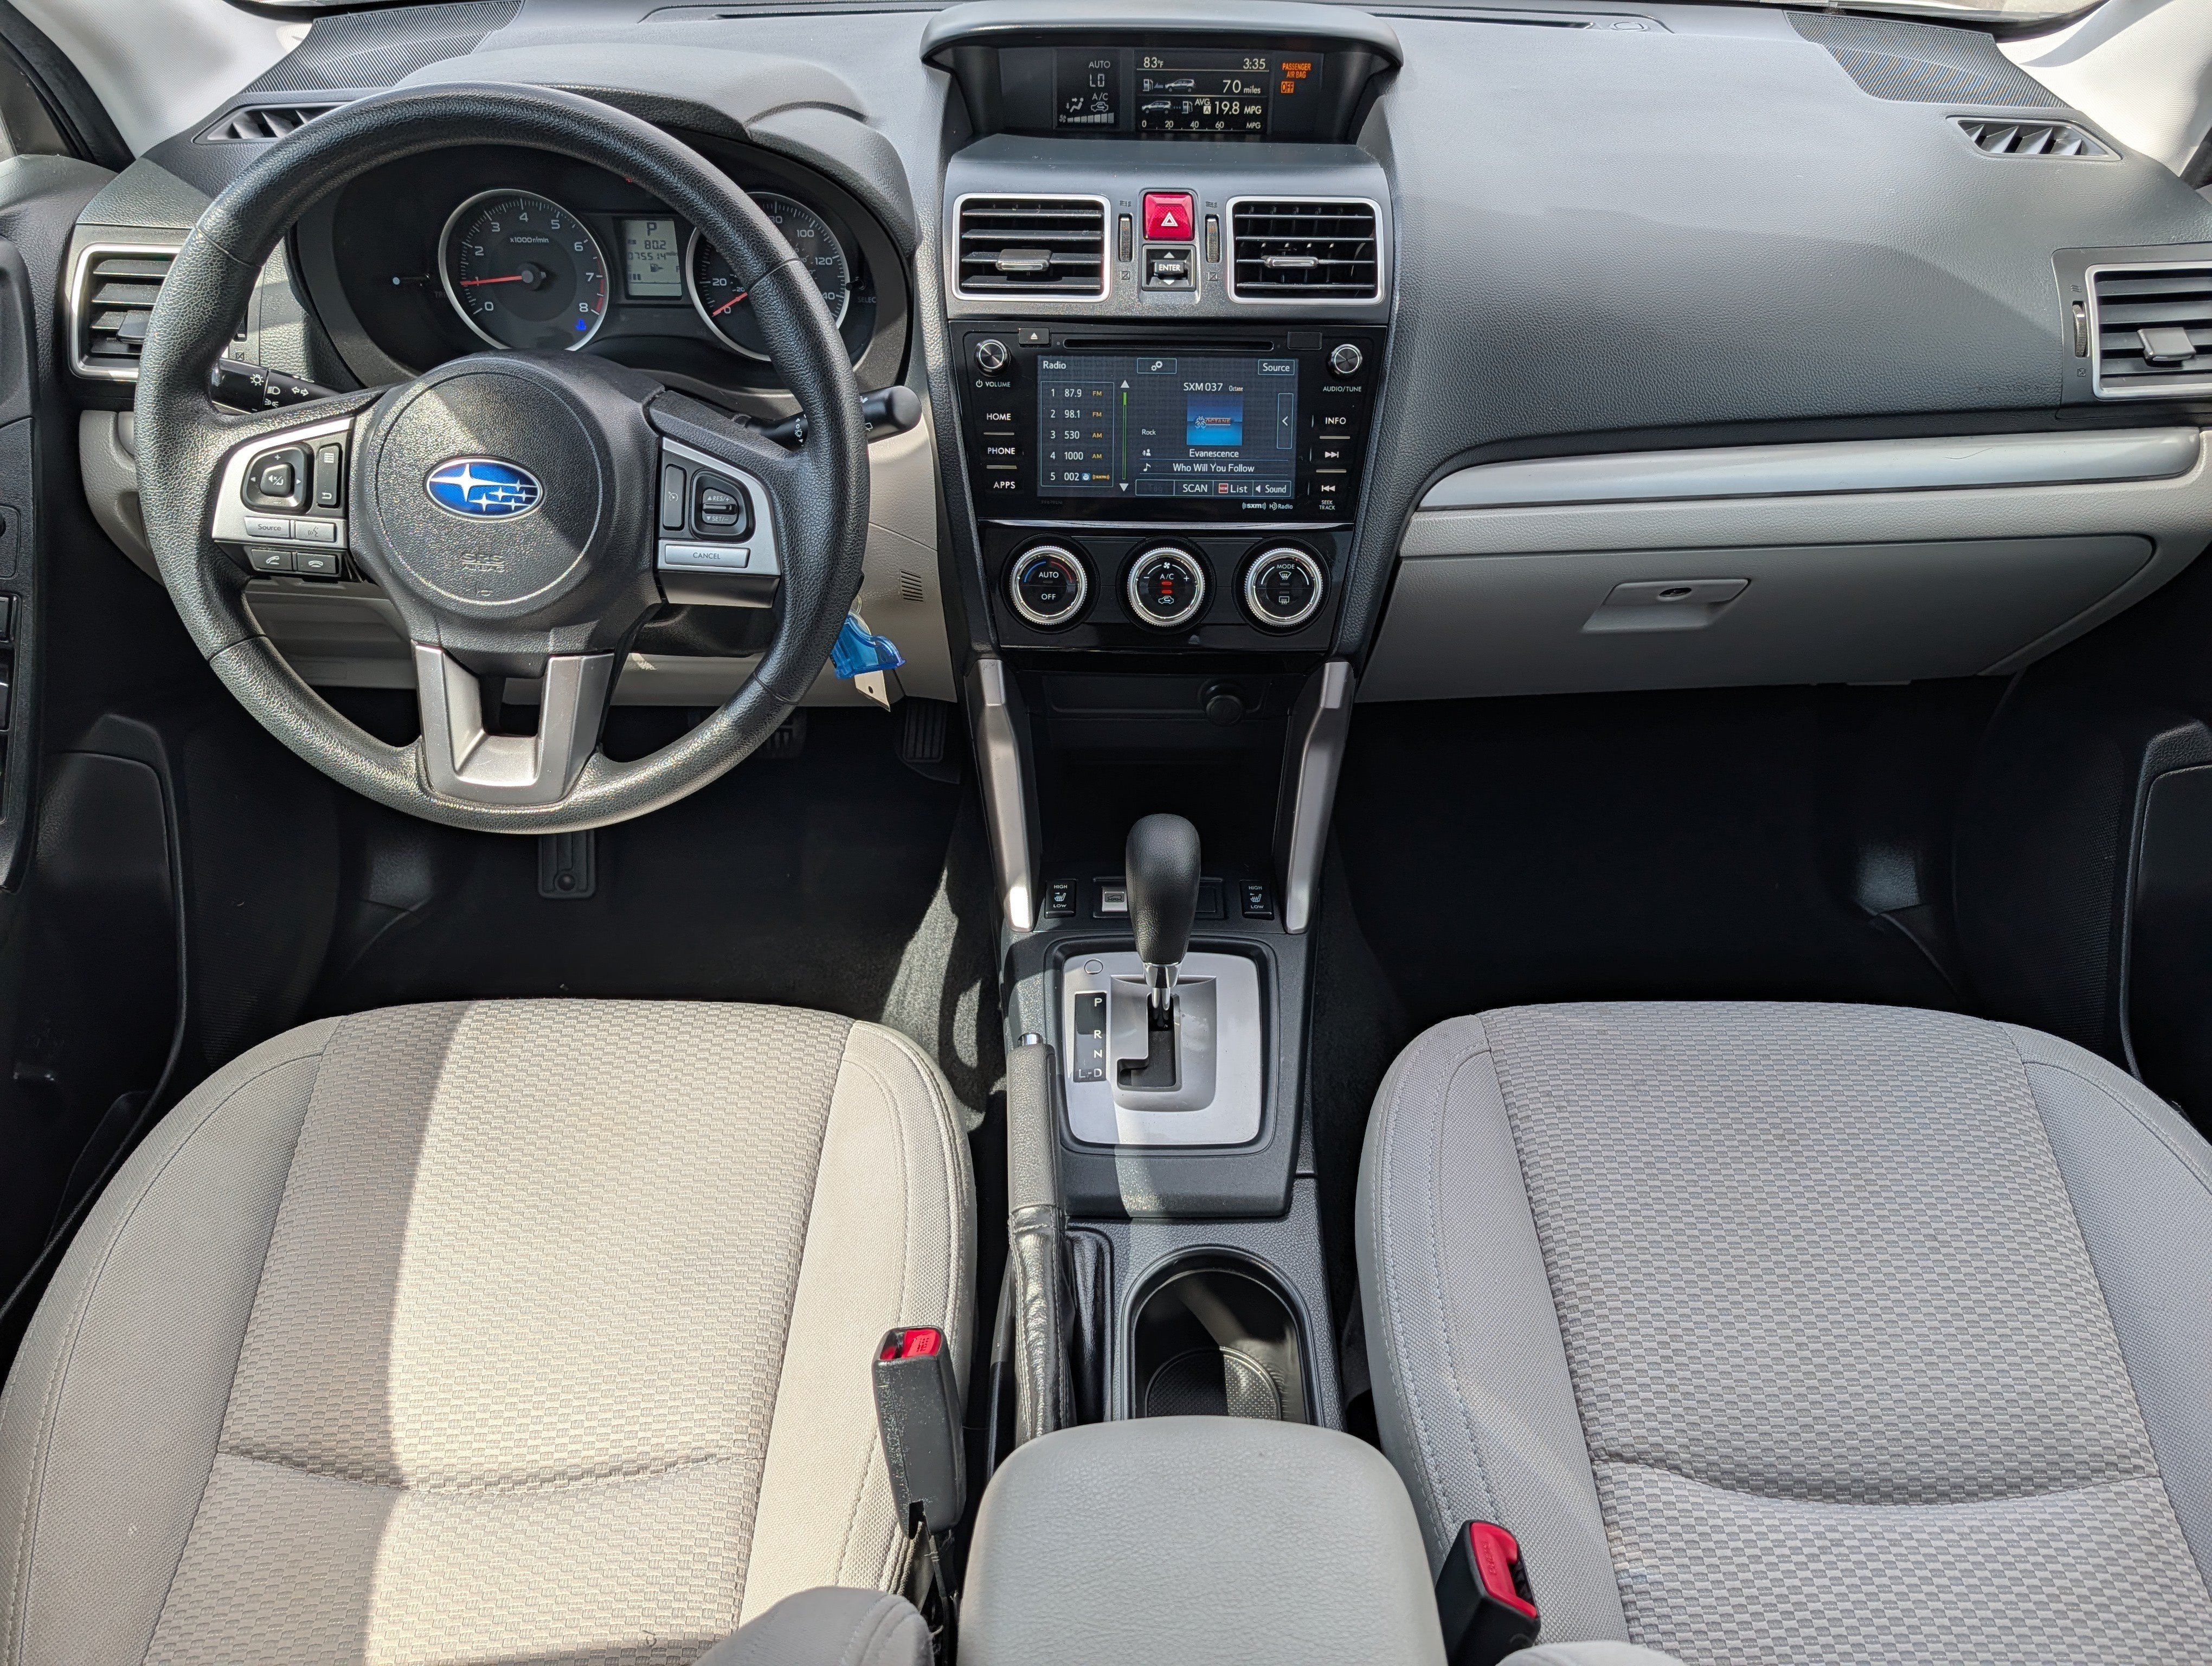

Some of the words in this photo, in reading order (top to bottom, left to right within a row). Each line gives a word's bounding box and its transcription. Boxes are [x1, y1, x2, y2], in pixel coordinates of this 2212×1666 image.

[1089, 60, 1110, 68] AUTO
[1243, 58, 1265, 69] 3:35
[1282, 62, 1311, 71] PASSENGER
[1090, 74, 1105, 87] LO
[1223, 80, 1242, 93] 70
[1281, 82, 1294, 93] OFF
[1092, 92, 1108, 101] A/C
[1215, 101, 1240, 115] 19.8
[1244, 106, 1262, 115] MPG
[519, 213, 529, 222] 4
[491, 222, 500, 232] 3
[551, 219, 560, 229] 5
[647, 222, 657, 236] P
[796, 229, 814, 238] 100
[574, 241, 583, 251] 6
[475, 246, 484, 256] 2
[815, 257, 833, 265] 120
[586, 273, 594, 281] 7
[485, 302, 493, 311] 0
[579, 303, 588, 312] 8
[1043, 361, 1066, 370] Radio
[1263, 362, 1290, 373] Source
[1184, 382, 1204, 392] SXM
[1205, 382, 1223, 392] 037
[1064, 389, 1082, 397] 87.9
[1050, 410, 1056, 418] 2
[1064, 410, 1081, 418] 98.1
[1325, 416, 1346, 425] INFO
[1050, 431, 1056, 439] 3
[1064, 431, 1080, 439] 530
[1064, 452, 1083, 460] 1000
[1189, 449, 1239, 458] Evanescence
[1173, 463, 1191, 472] Who
[1194, 463, 1208, 472] Will
[1210, 463, 1226, 473] You
[1228, 464, 1255, 473] Follow
[1050, 472, 1056, 480] 5
[1064, 473, 1079, 481] 002
[993, 481, 1015, 489] APPS
[1182, 484, 1208, 492] SCAN
[1230, 485, 1248, 493] List
[1265, 485, 1287, 493] Sound
[462, 554, 504, 564] SRS
[1094, 998, 1102, 1007] P
[1094, 1030, 1102, 1039] R
[1094, 1049, 1102, 1058] N
